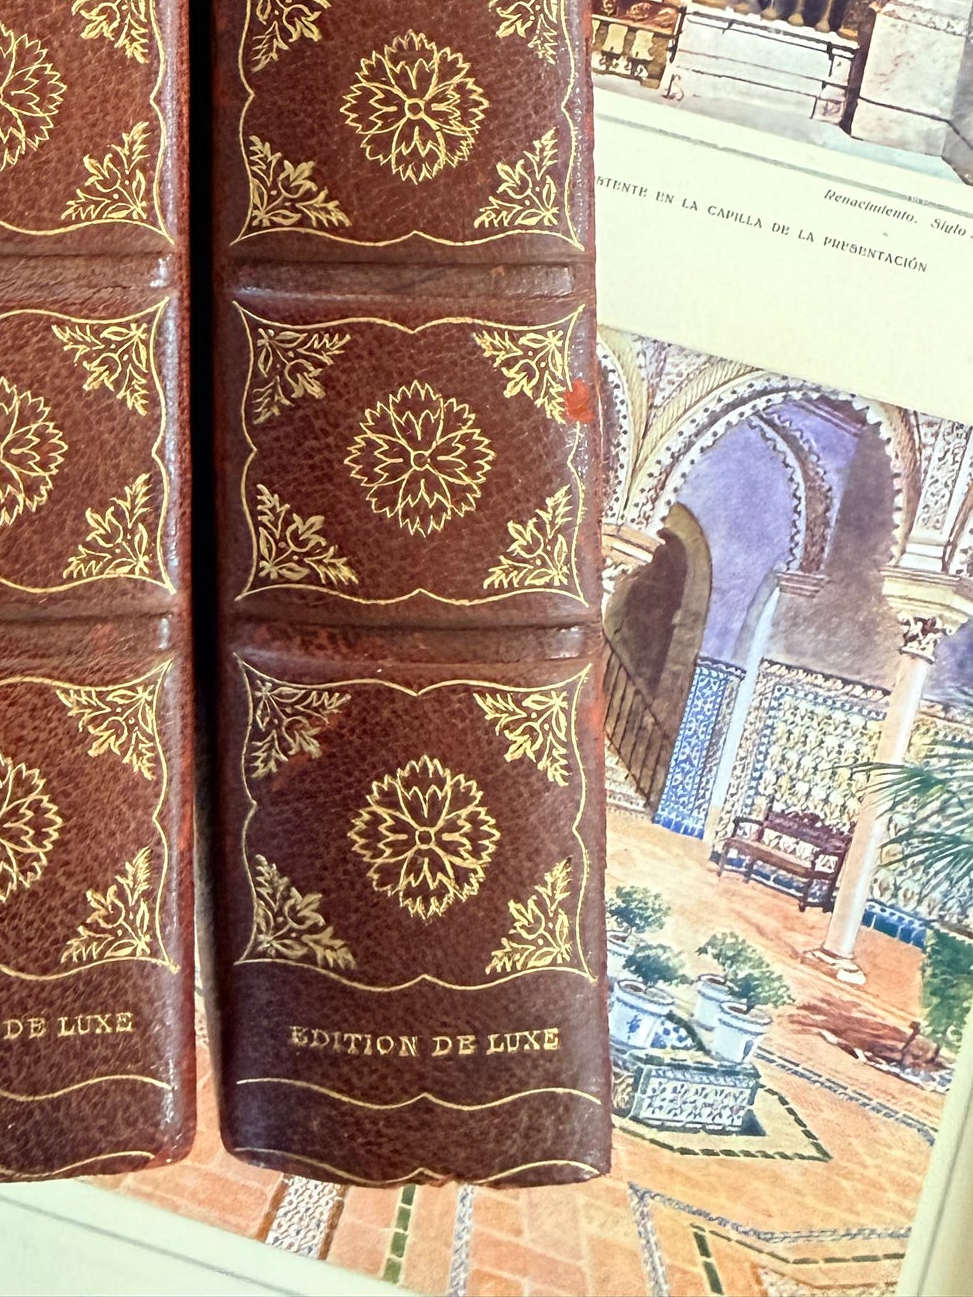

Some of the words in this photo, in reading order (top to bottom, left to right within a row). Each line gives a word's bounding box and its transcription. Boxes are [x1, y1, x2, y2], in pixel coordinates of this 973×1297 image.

[656, 191, 674, 204] EN
[682, 198, 698, 211] LA
[707, 205, 763, 228] CAPILLA
[772, 222, 790, 236] DE
[798, 229, 814, 242] LA
[823, 236, 927, 272] PRESENTACIÓN
[824, 189, 918, 224] Renacimiento.
[931, 218, 967, 238] Siglo
[3, 1017, 47, 1040] DE
[57, 1012, 134, 1036] LUXE
[289, 1026, 418, 1056] EDITION
[431, 1035, 476, 1056] DE
[486, 1028, 560, 1054] LUXE
